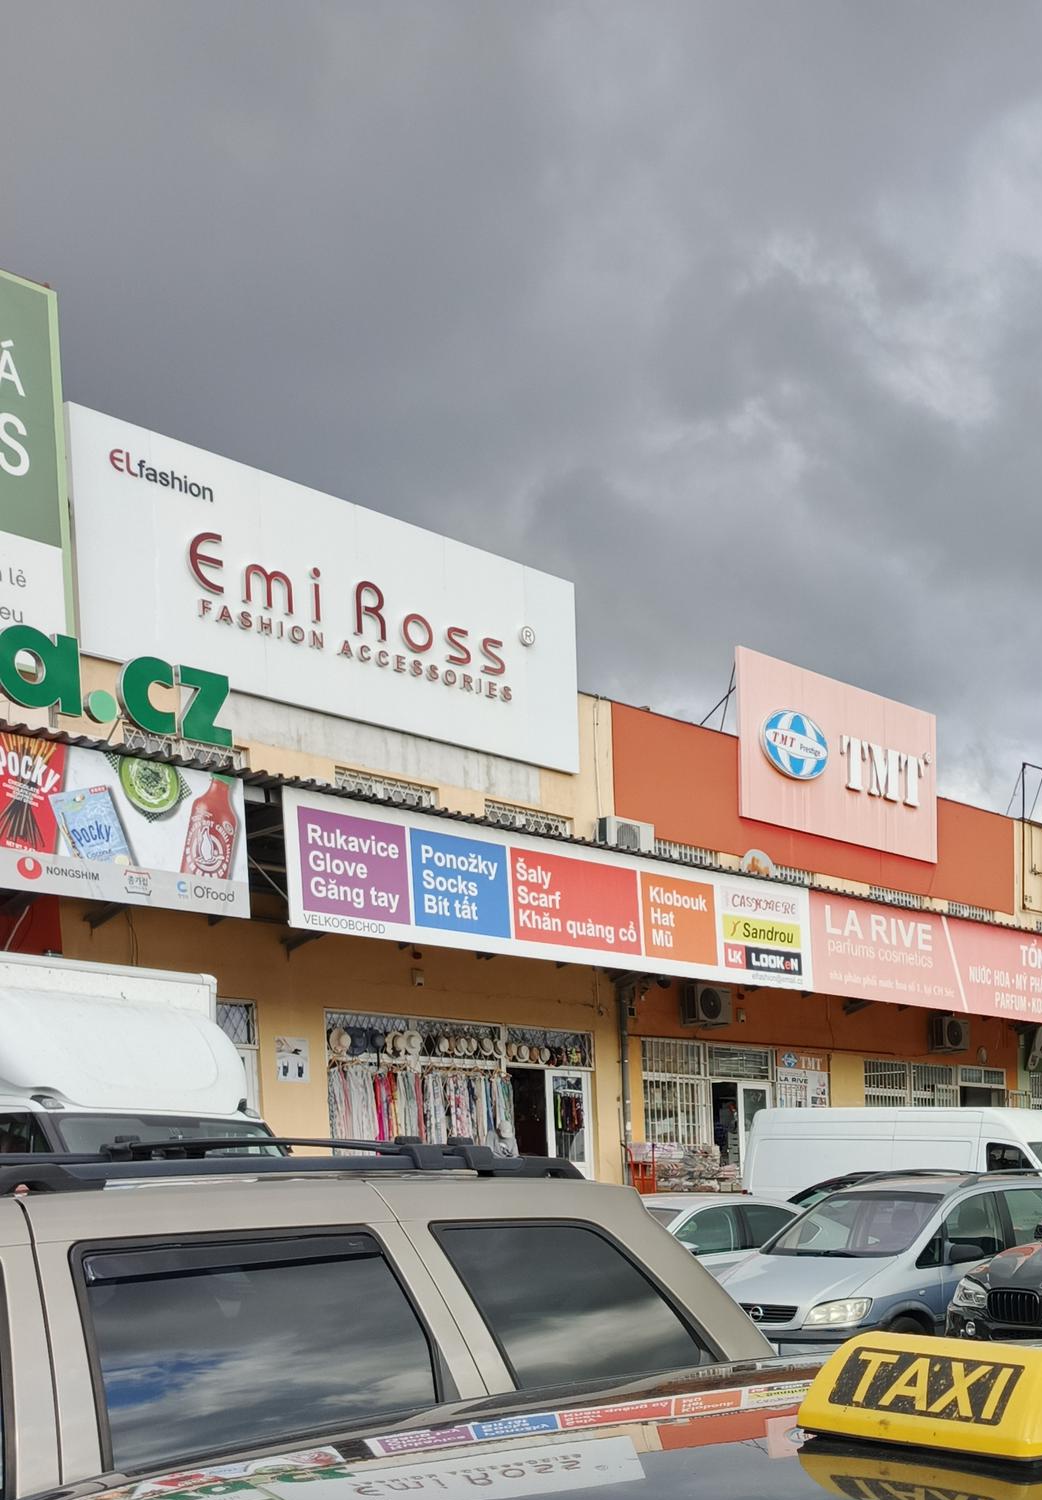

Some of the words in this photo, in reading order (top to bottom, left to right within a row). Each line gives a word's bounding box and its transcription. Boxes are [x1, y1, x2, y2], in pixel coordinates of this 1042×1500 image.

[109, 448, 214, 502] ELfashion
[187, 531, 321, 623] Emi
[198, 598, 325, 649] FASHION
[336, 639, 513, 702] ACCESSORIES
[771, 731, 796, 748] TMT
[840, 734, 925, 809] TMT
[306, 823, 399, 859] Rukavice
[46, 866, 100, 881] NONGSHIM
[308, 850, 368, 879] Glove
[421, 845, 498, 880] Ponožky
[515, 857, 551, 889] Šaly
[310, 876, 364, 907] Găng
[370, 887, 400, 912] tay
[422, 870, 478, 897] Socks
[517, 886, 561, 909] Scarf
[424, 894, 450, 916] Bít
[649, 886, 708, 913] Klobouk
[303, 913, 386, 935] VELKOOBCHOD
[518, 908, 561, 935] Khăn
[566, 919, 615, 944] quàng
[619, 920, 637, 943] cổ
[650, 907, 675, 928] Hat
[824, 904, 864, 939] LA
[869, 913, 934, 951] RIVE
[652, 928, 673, 948] Mũ
[742, 922, 794, 944] Sandrou
[827, 937, 876, 960] parfums
[878, 948, 934, 969] cosmetics
[993, 969, 1011, 989] HOA
[994, 991, 1027, 1012] PARFUM
[852, 1350, 1016, 1420] TAXI
